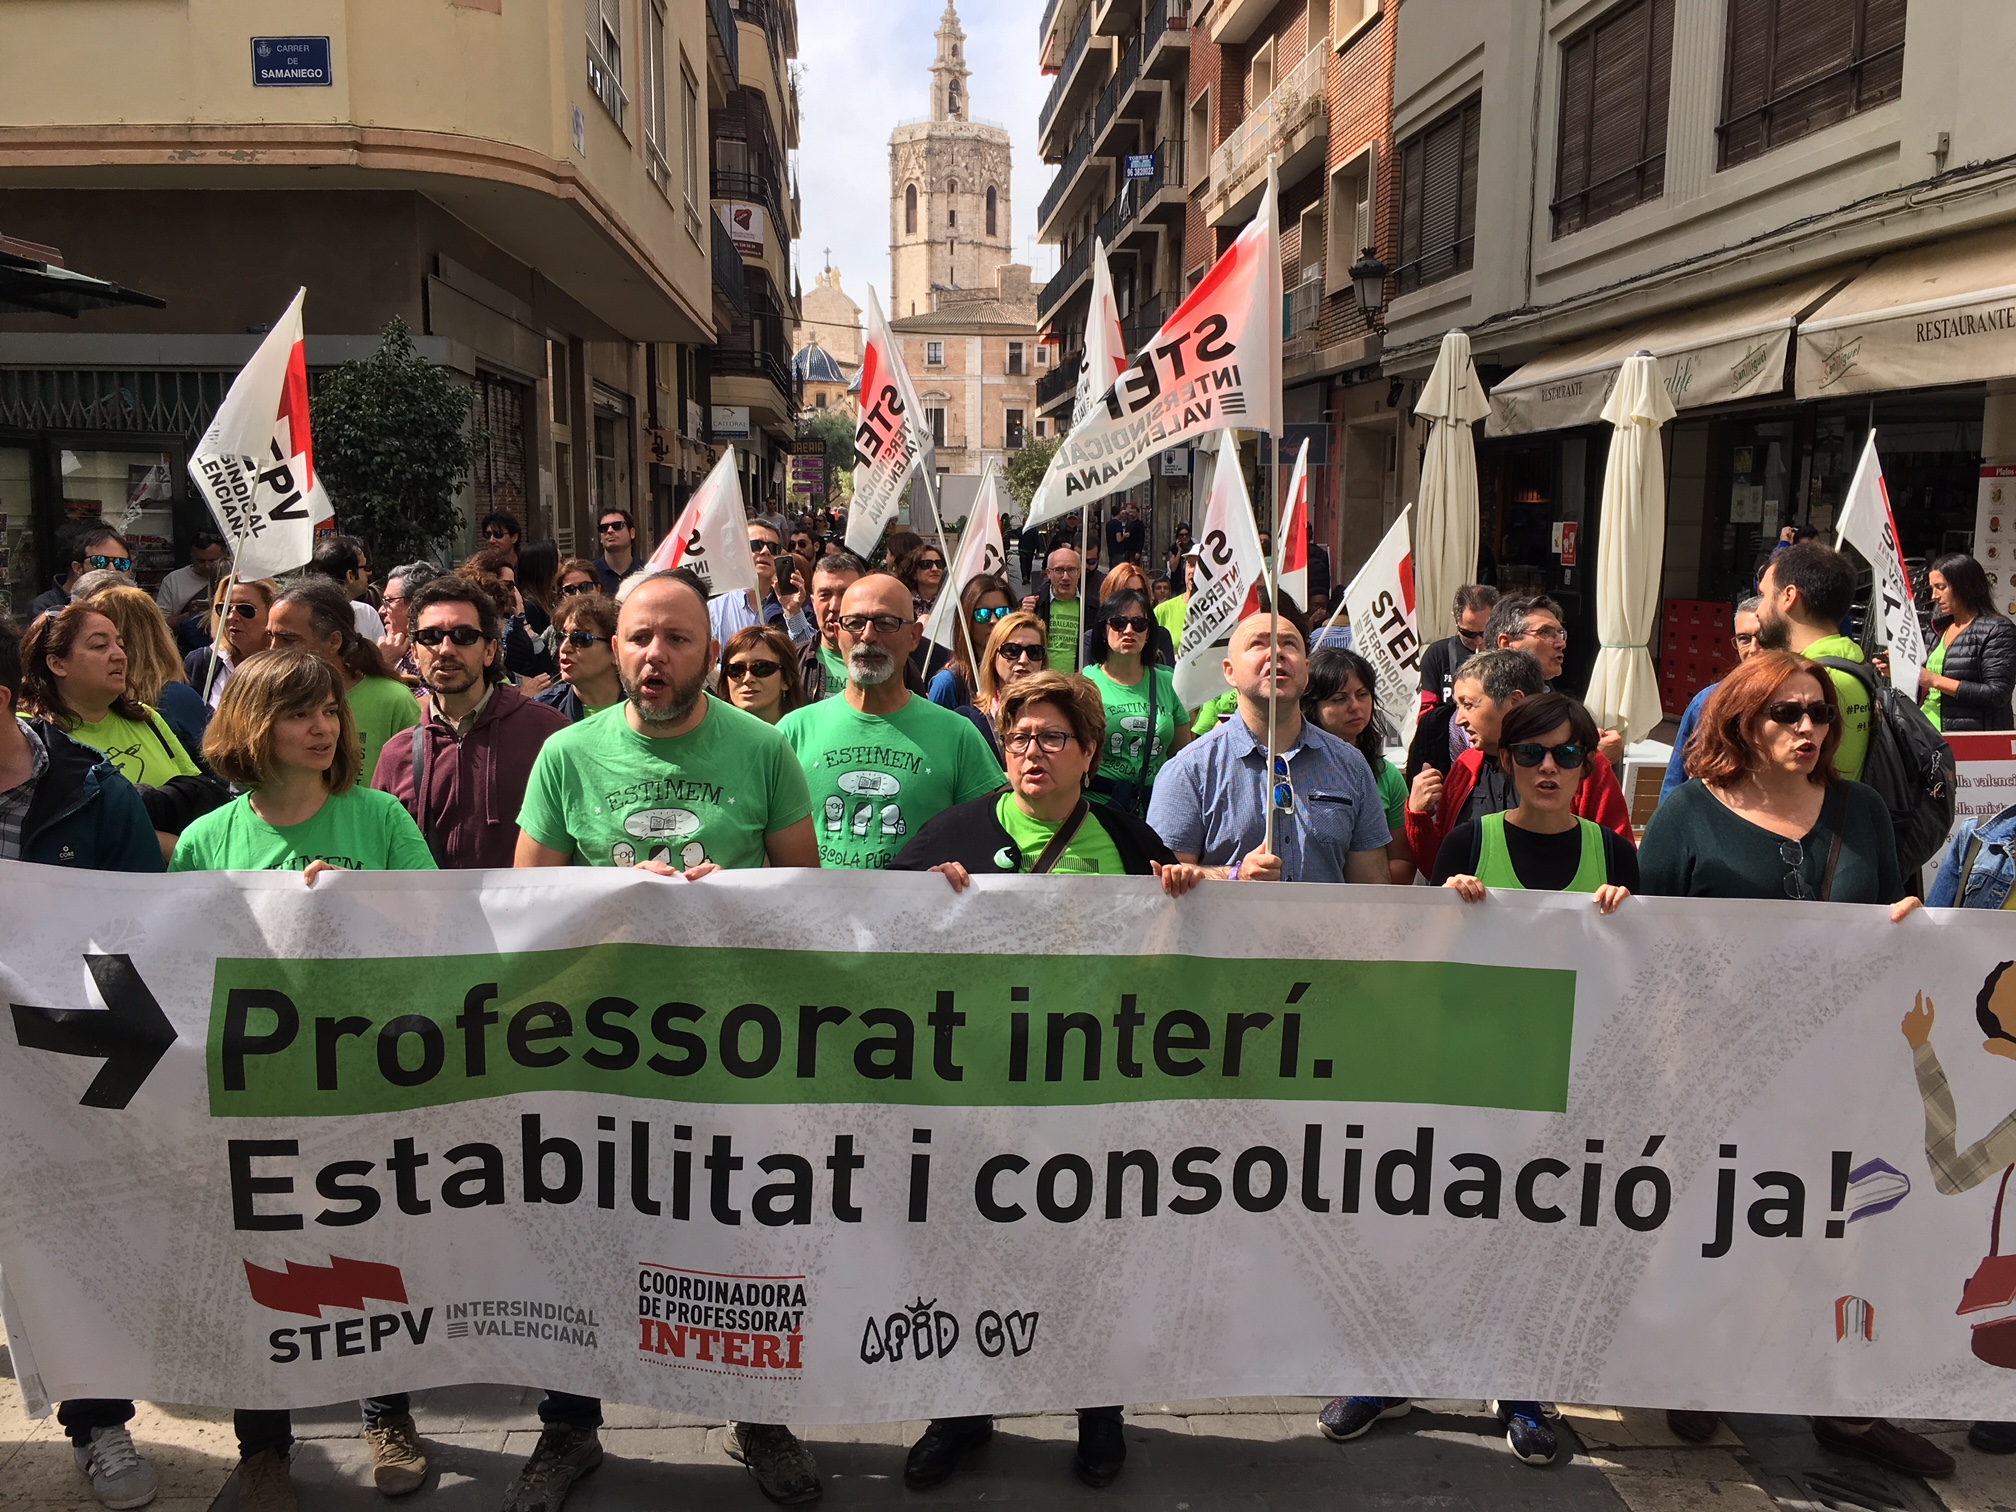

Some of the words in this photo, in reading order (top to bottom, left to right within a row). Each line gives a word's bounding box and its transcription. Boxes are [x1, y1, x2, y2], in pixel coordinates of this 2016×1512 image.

[276, 44, 310, 53] CARRER
[287, 57, 299, 65] DE
[261, 68, 323, 79] SAMANIEGO
[1916, 306, 2016, 343] RESTAURANTE
[1541, 381, 1584, 402] RESTAURANTE
[1372, 590, 1422, 676] STEP
[1107, 701, 1166, 716] ESTIMM
[823, 746, 923, 775] ESTIMEM
[605, 778, 724, 812] ESTIMEM
[818, 844, 860, 867] SCOLA
[222, 983, 966, 1091] Professorat
[1008, 982, 1333, 1082] interí.
[228, 1114, 865, 1231] Estabilitat
[908, 1128, 932, 1222] i
[974, 1124, 1672, 1232] consolidació
[1702, 1144, 1854, 1258] ja!
[638, 1269, 807, 1307] COORDINADORA
[446, 1300, 600, 1328] INTERSINDICAL
[638, 1295, 661, 1318] DE
[666, 1297, 804, 1333] PROFESSORAT
[269, 1307, 435, 1364] STEPV
[473, 1320, 599, 1349] VALENCIANA
[638, 1317, 805, 1369] INTERÍ
[975, 1309, 1040, 1358] CV
